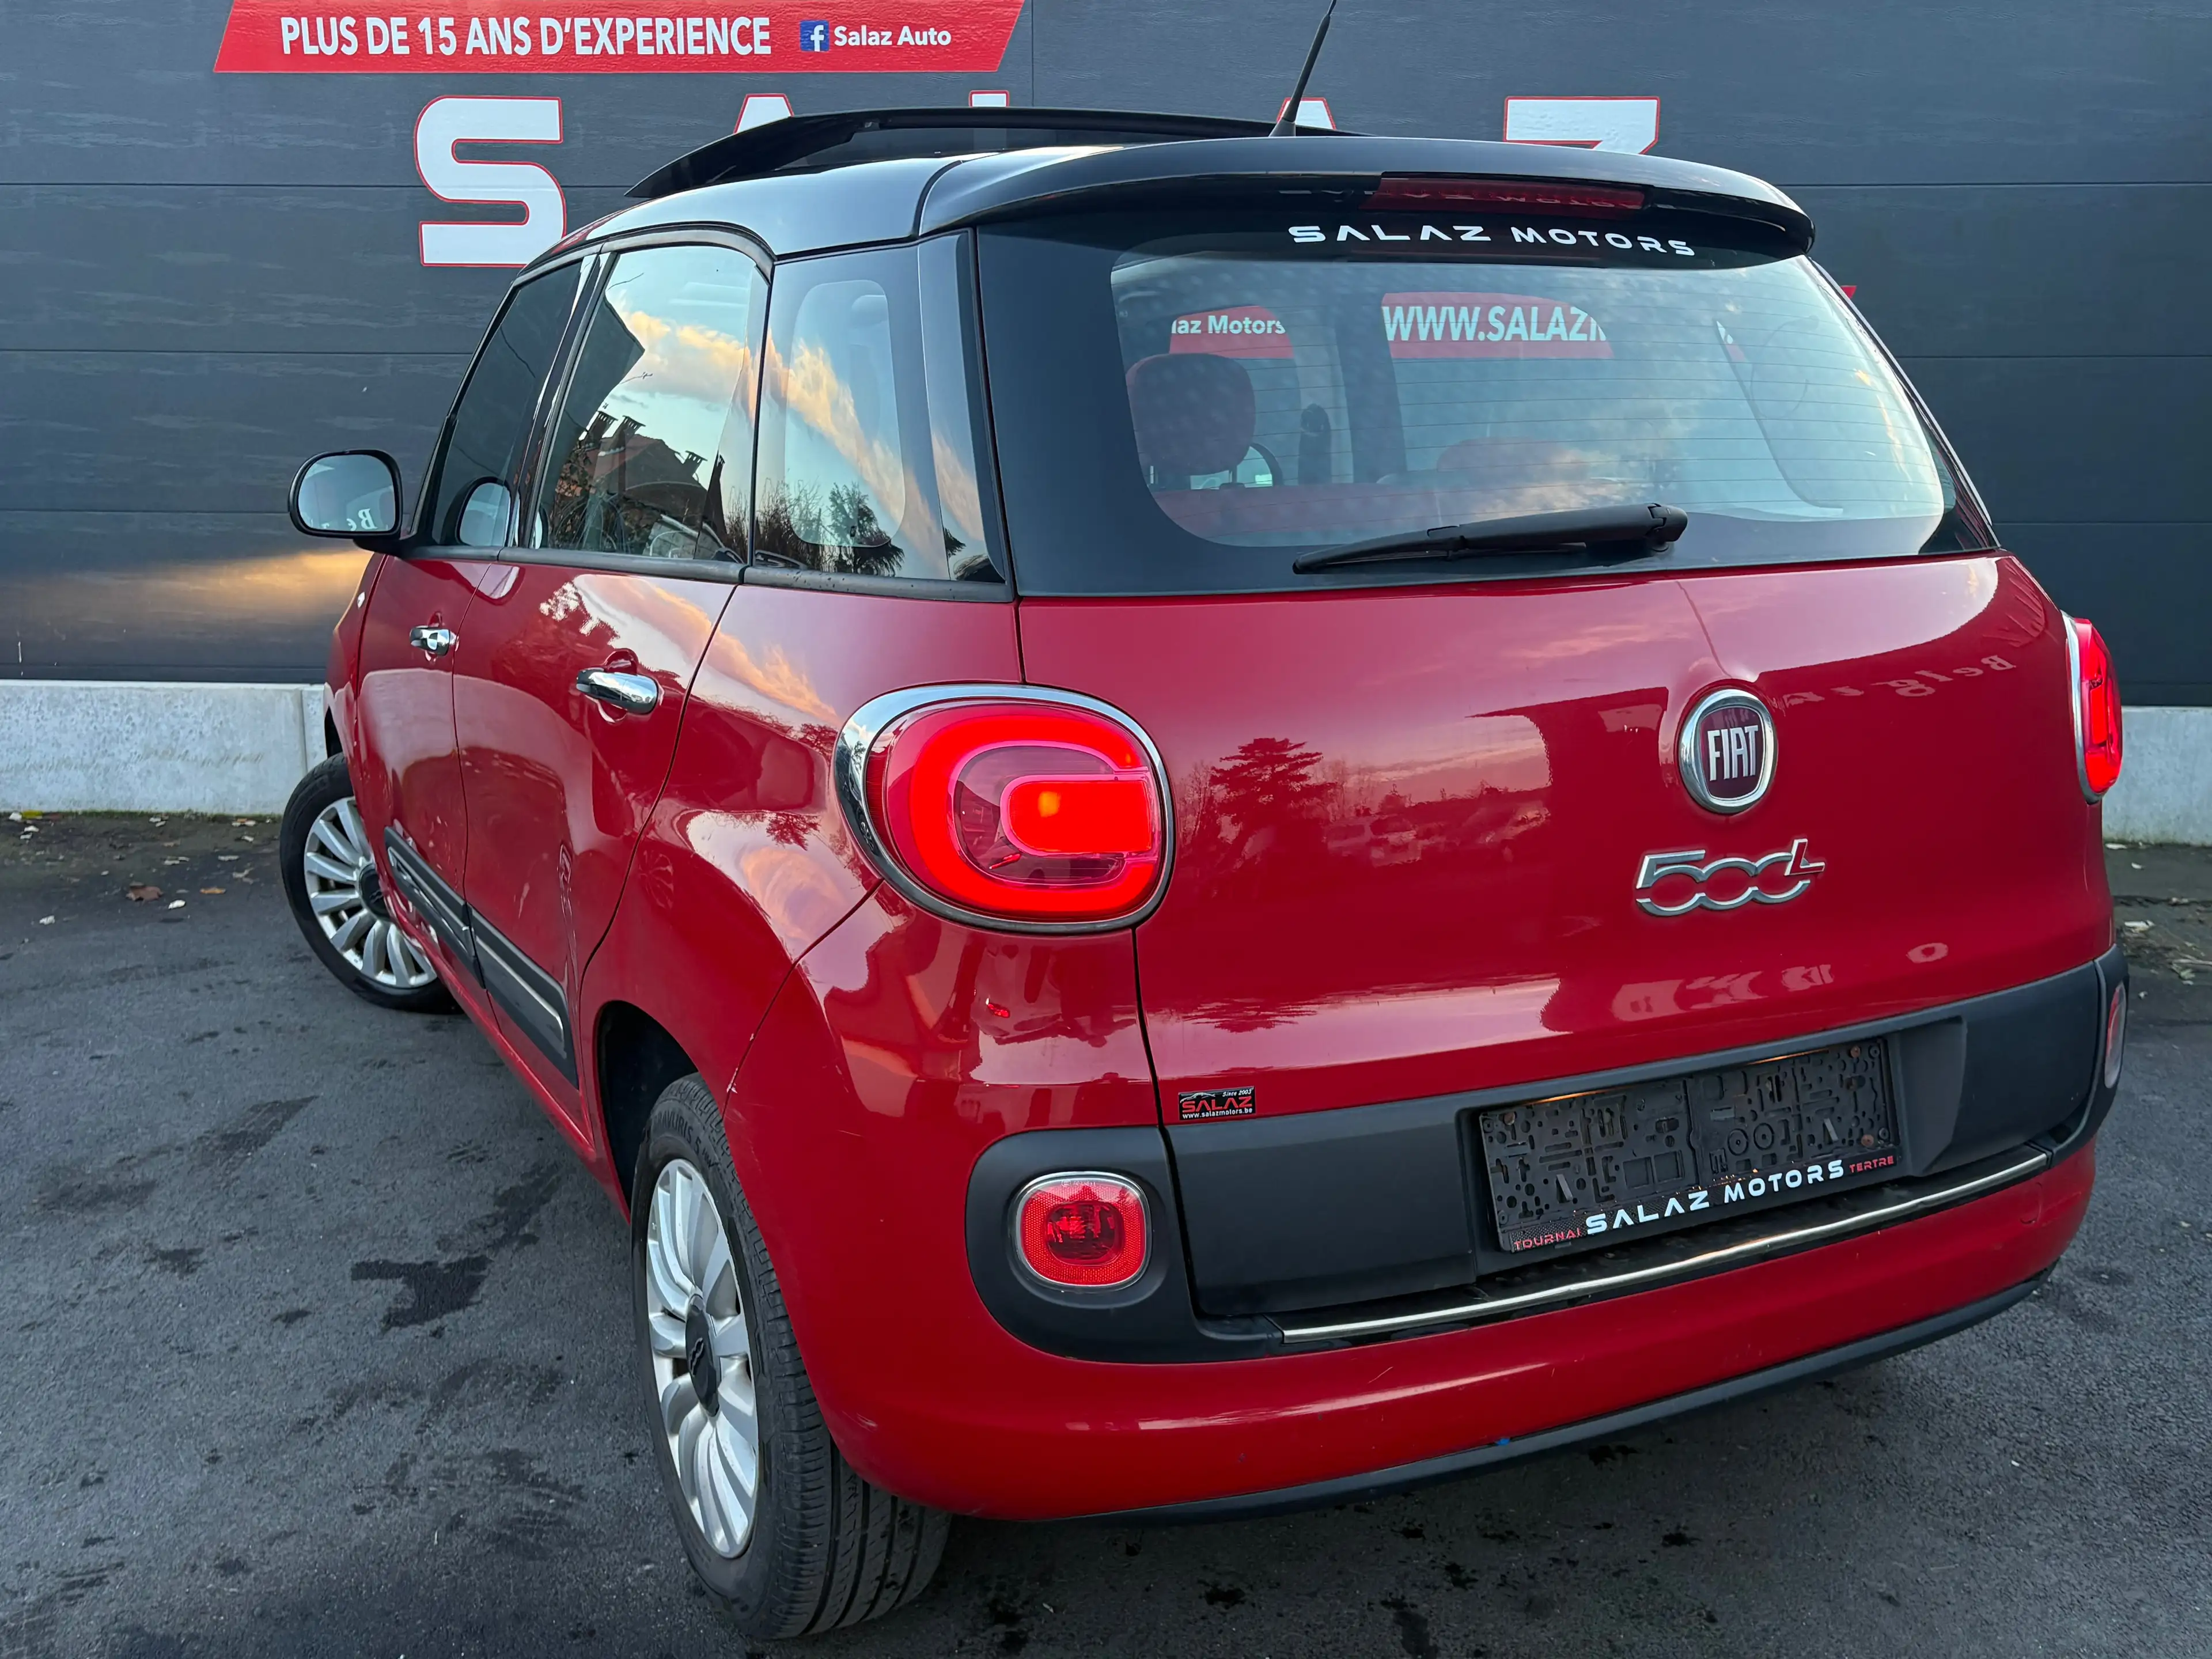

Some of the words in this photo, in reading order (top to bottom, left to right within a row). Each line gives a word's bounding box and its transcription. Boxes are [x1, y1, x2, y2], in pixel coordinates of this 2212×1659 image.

[281, 16, 358, 56] PLUS
[366, 17, 410, 55] DE
[418, 17, 457, 55] 15
[465, 17, 532, 55] ANS
[834, 25, 892, 46] Salaz
[897, 26, 951, 46] Auto
[1288, 225, 1491, 243] SALAZ
[1510, 226, 1695, 256] MOTORS
[1707, 725, 1759, 782] FIAT
[1182, 1096, 1252, 1113] SALAZ
[1182, 1107, 1253, 1119] www.salazmotors.be
[1513, 1227, 1582, 1252] TOURNAI
[1585, 1190, 1710, 1235] SALAZ
[1724, 1159, 1844, 1205] MOTORS
[1849, 1155, 1895, 1173] TERTRE
